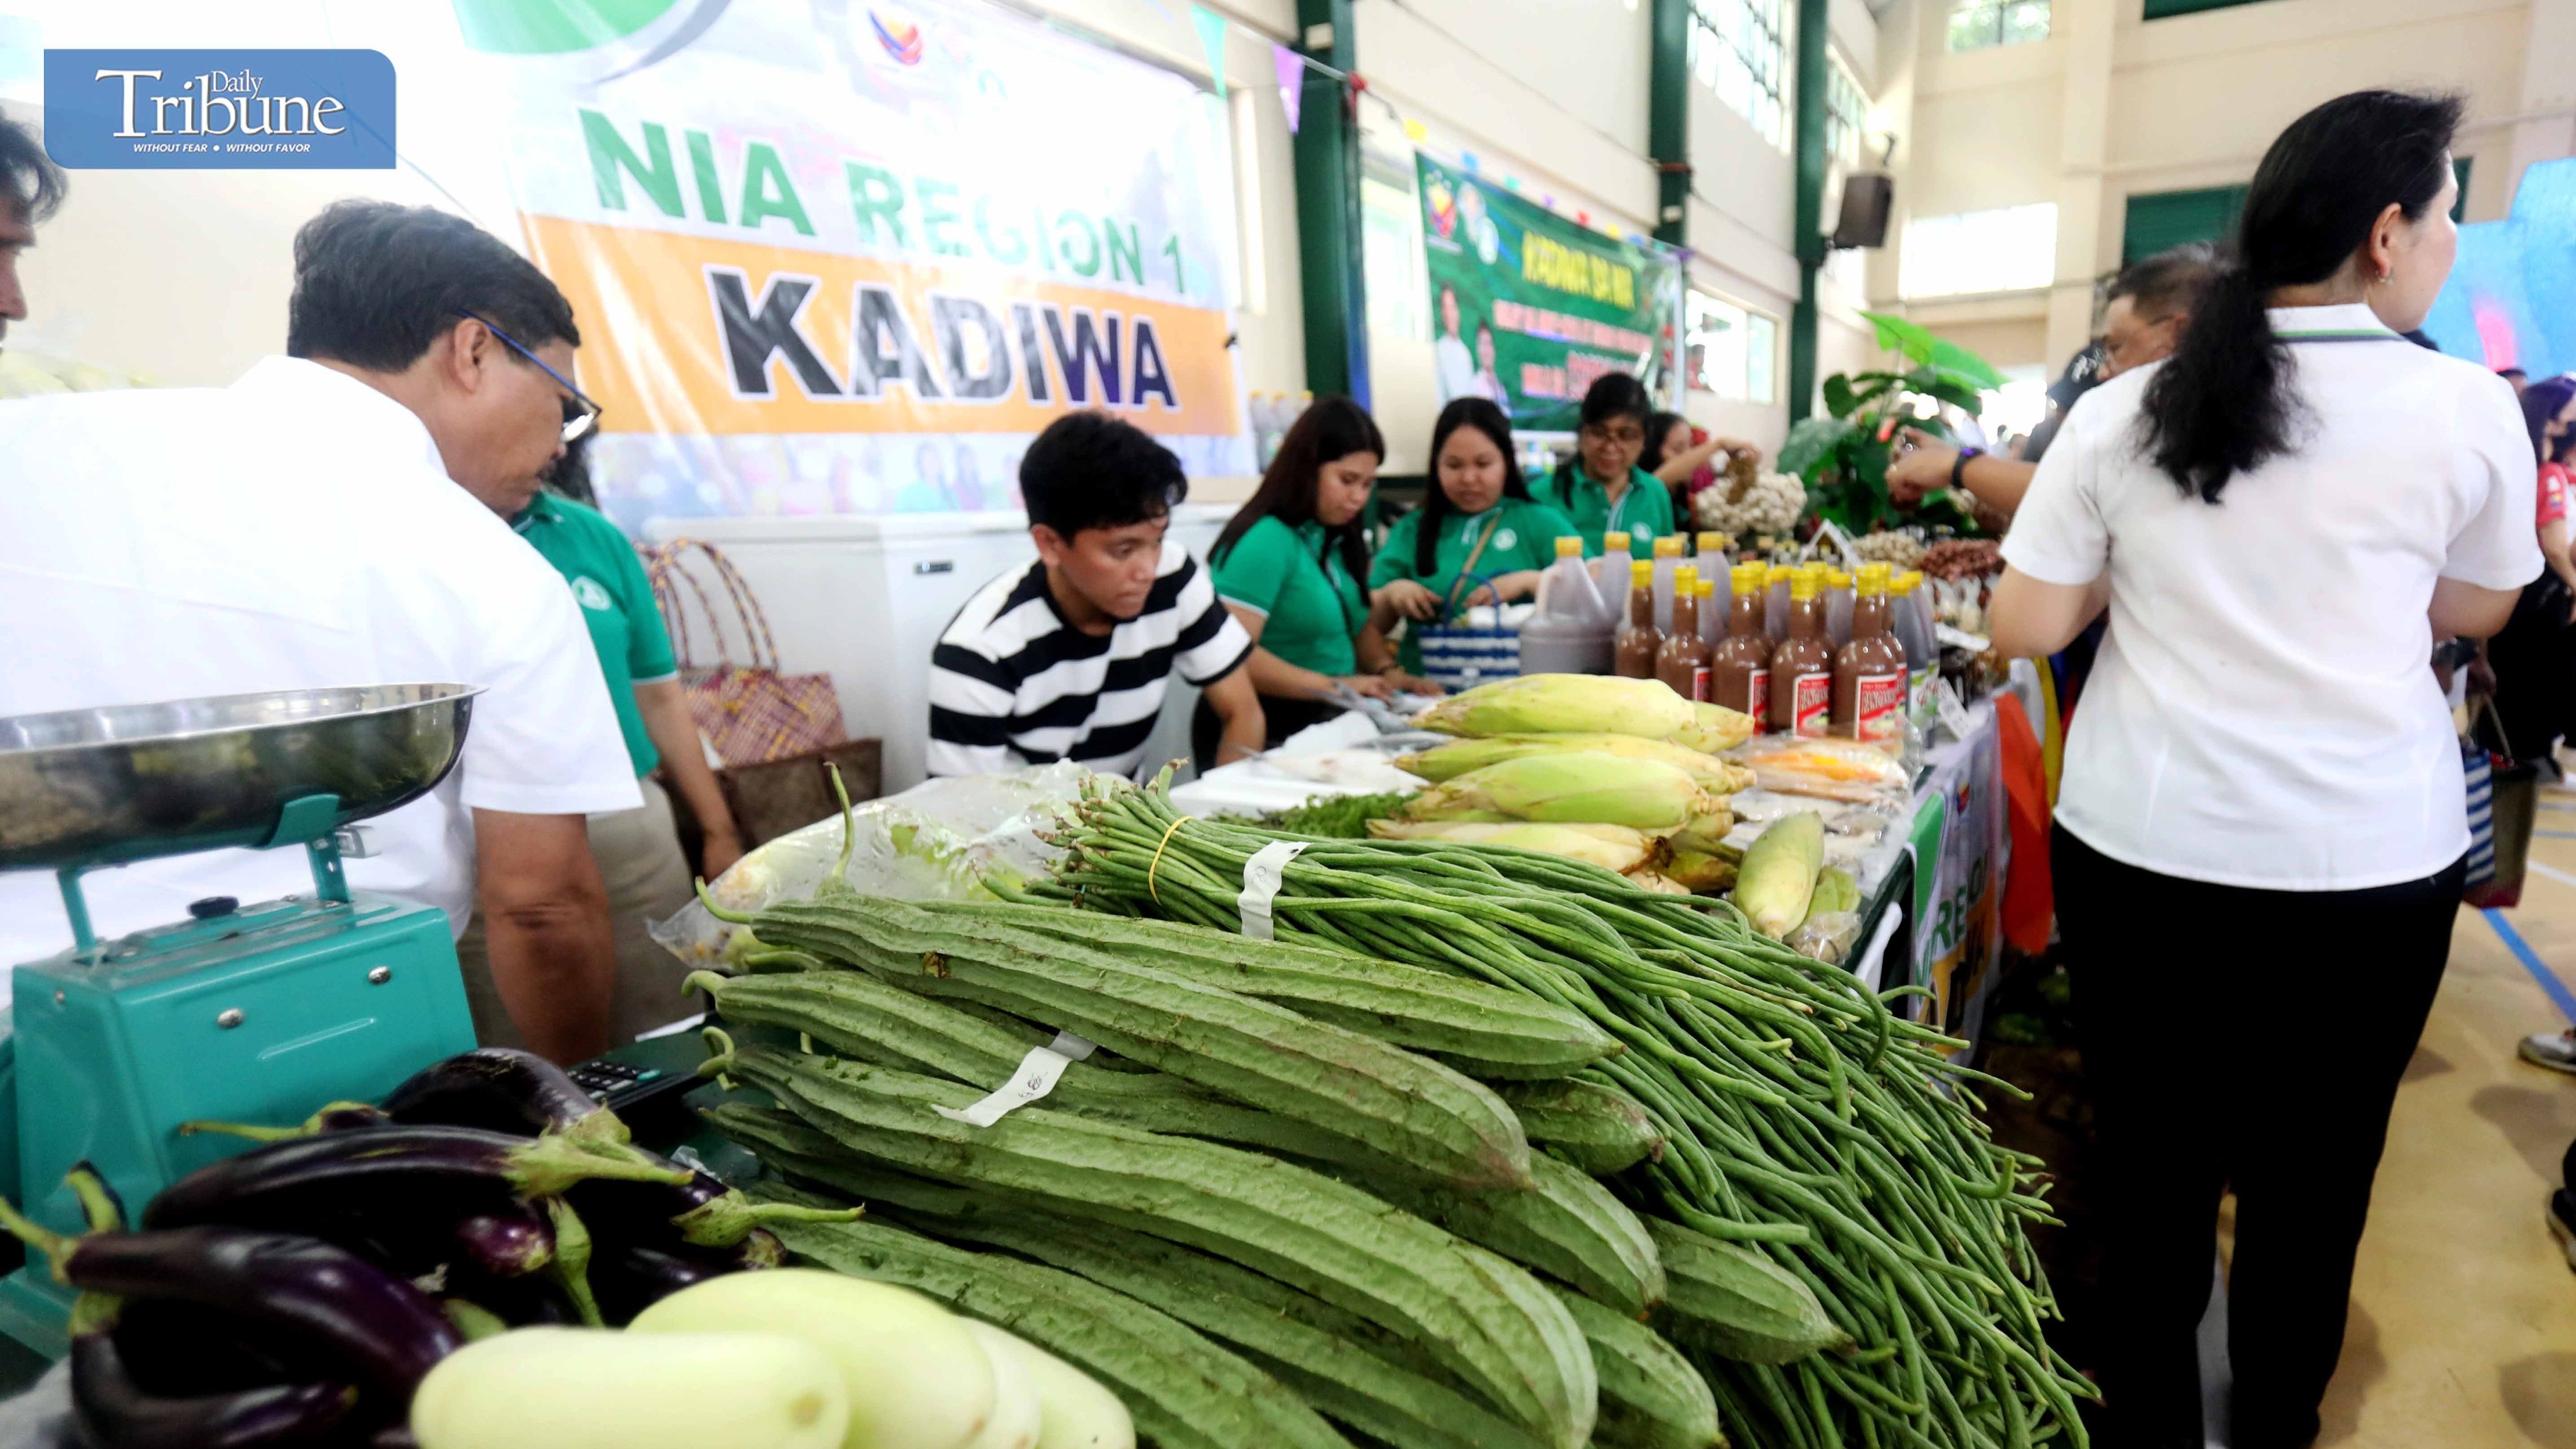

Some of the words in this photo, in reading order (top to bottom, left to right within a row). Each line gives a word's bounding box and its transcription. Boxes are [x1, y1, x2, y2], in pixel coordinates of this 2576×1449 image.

[581, 110, 817, 238] NIA
[846, 161, 1147, 286] REGION
[1163, 235, 1186, 294] 1
[709, 269, 1179, 409] KADIWA
